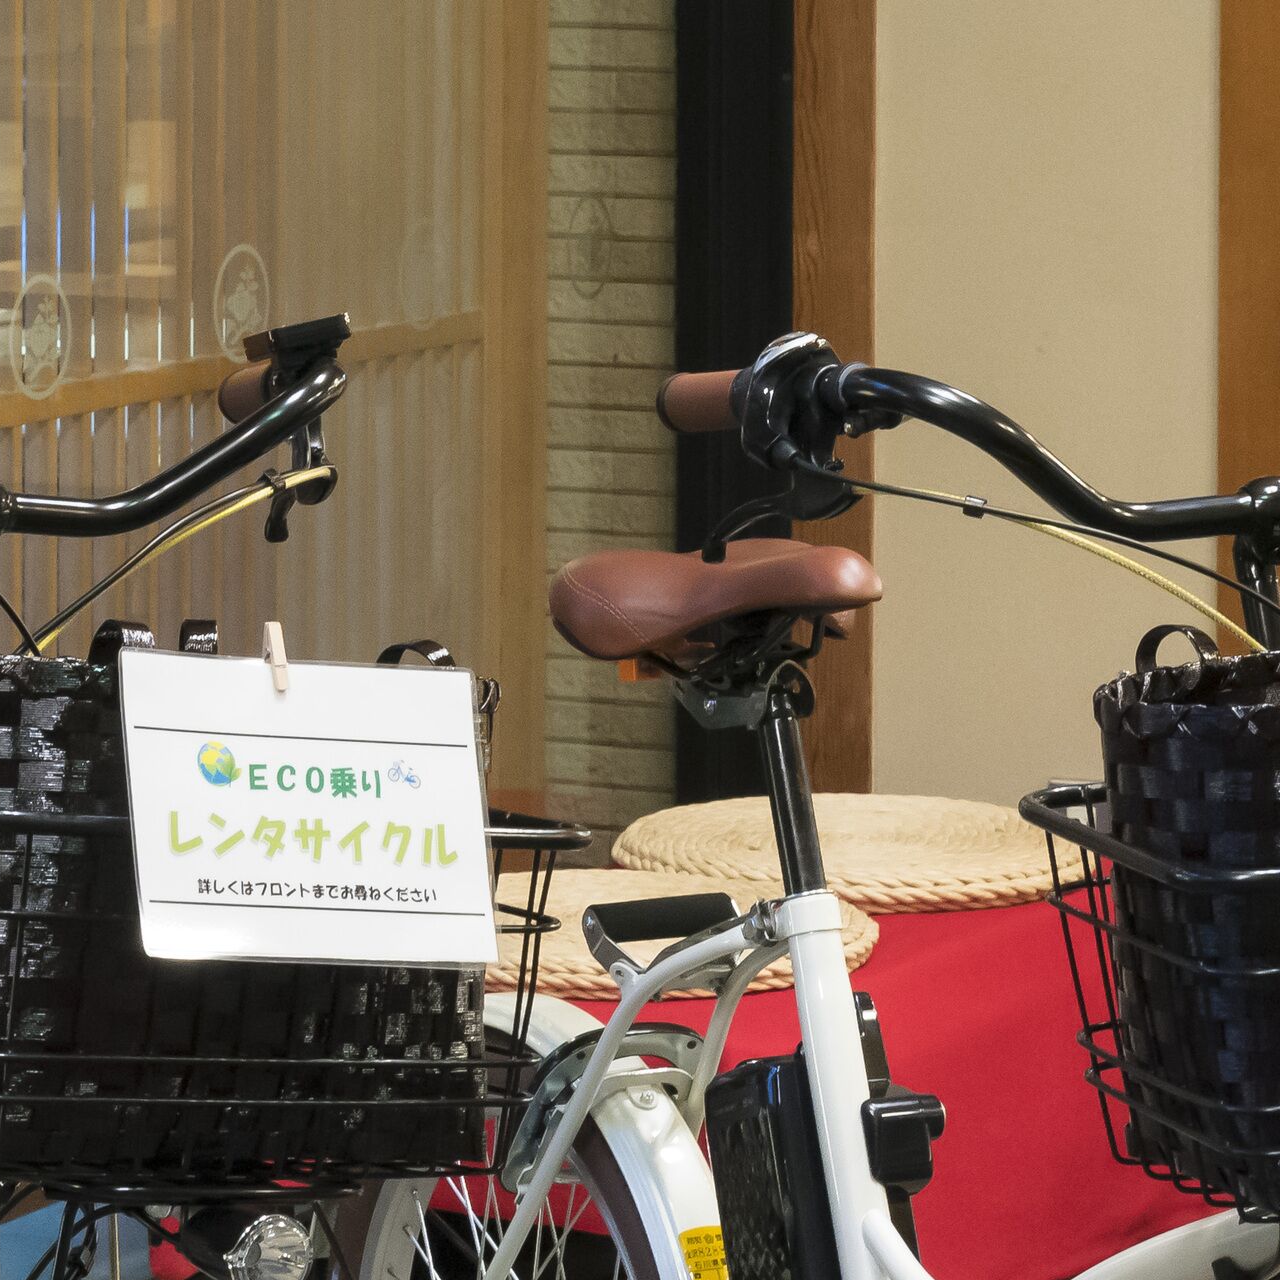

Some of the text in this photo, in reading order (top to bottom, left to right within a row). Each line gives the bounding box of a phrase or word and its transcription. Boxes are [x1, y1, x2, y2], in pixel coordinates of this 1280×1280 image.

[249, 763, 383, 799] ECO乗り
[168, 810, 459, 869] レンタサイクル
[198, 878, 438, 903] 詳しくはフロントまでお尋ねください
